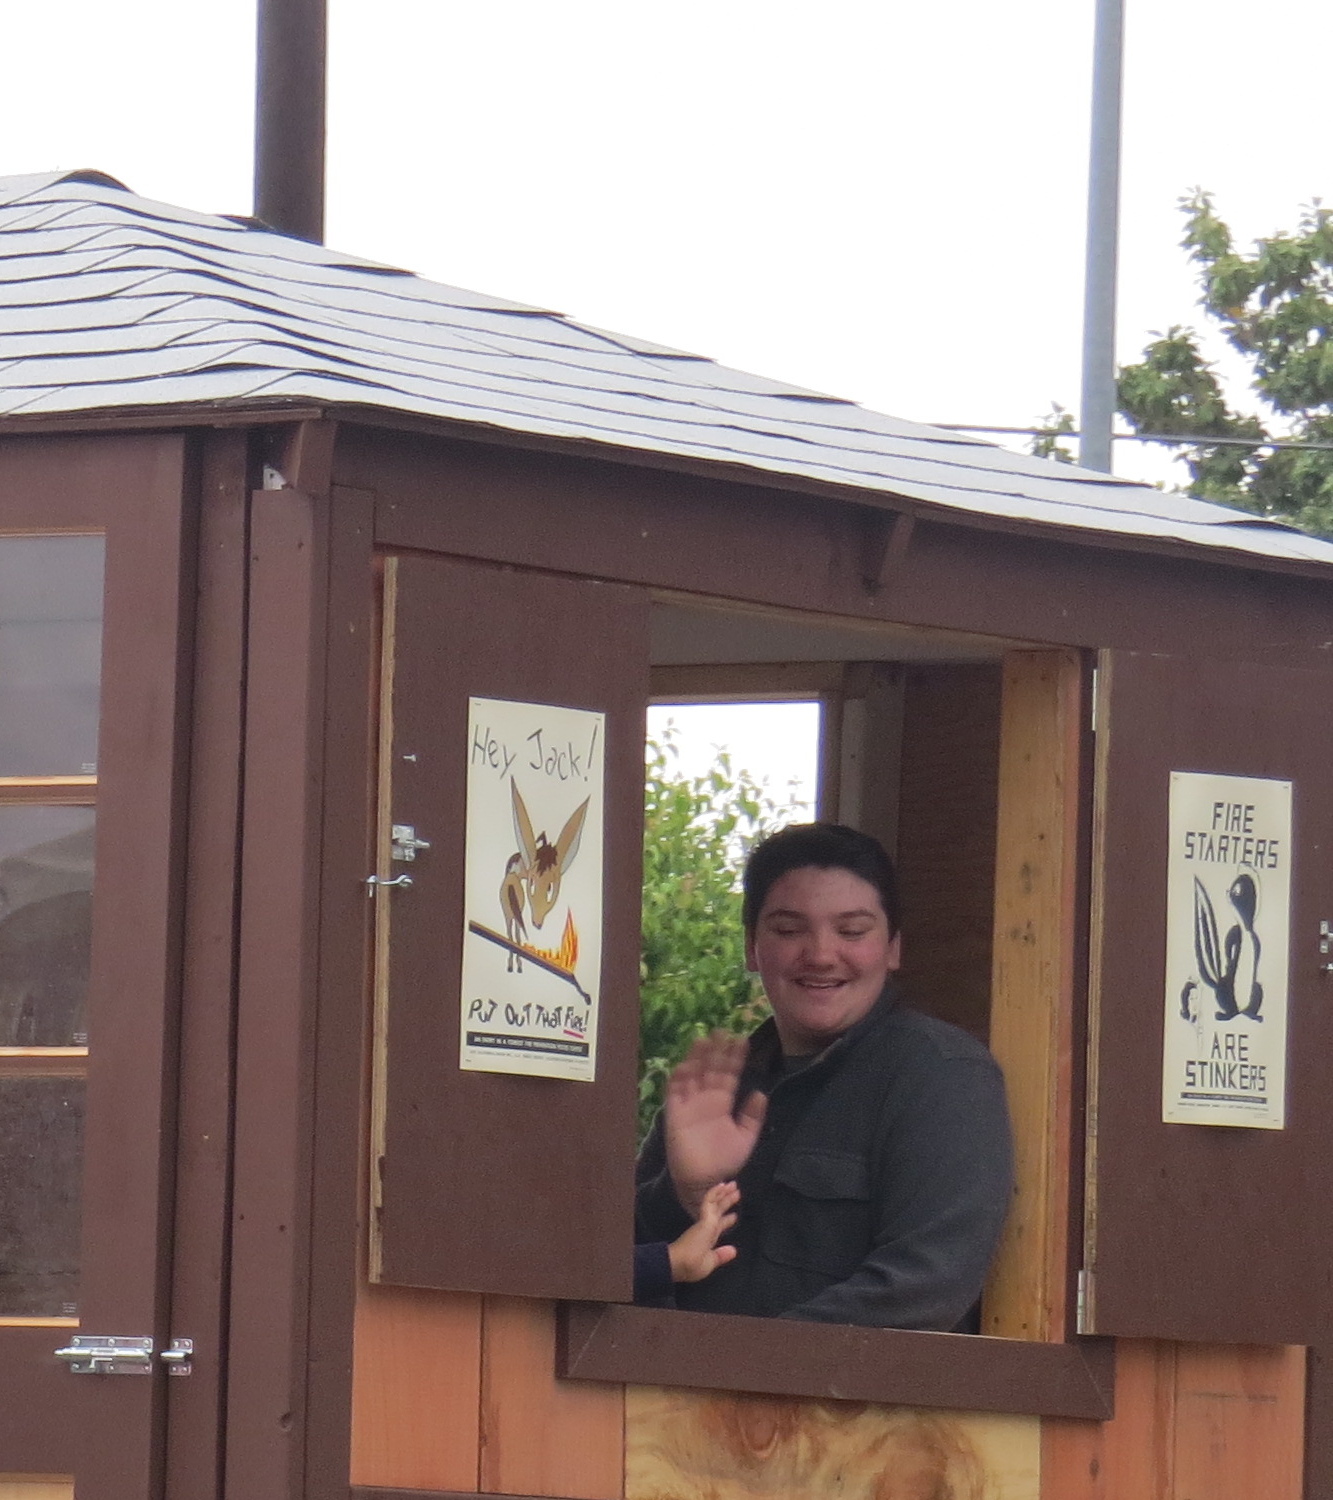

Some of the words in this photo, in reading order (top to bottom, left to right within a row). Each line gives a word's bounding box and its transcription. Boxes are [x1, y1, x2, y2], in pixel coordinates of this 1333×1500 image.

[471, 724, 517, 780] Hey
[526, 724, 598, 782] Jack!
[1212, 802, 1255, 833] FIRE
[1185, 831, 1279, 868] STARTERS
[1211, 1032, 1250, 1062] ARE
[1185, 1060, 1267, 1091] STINKERS
